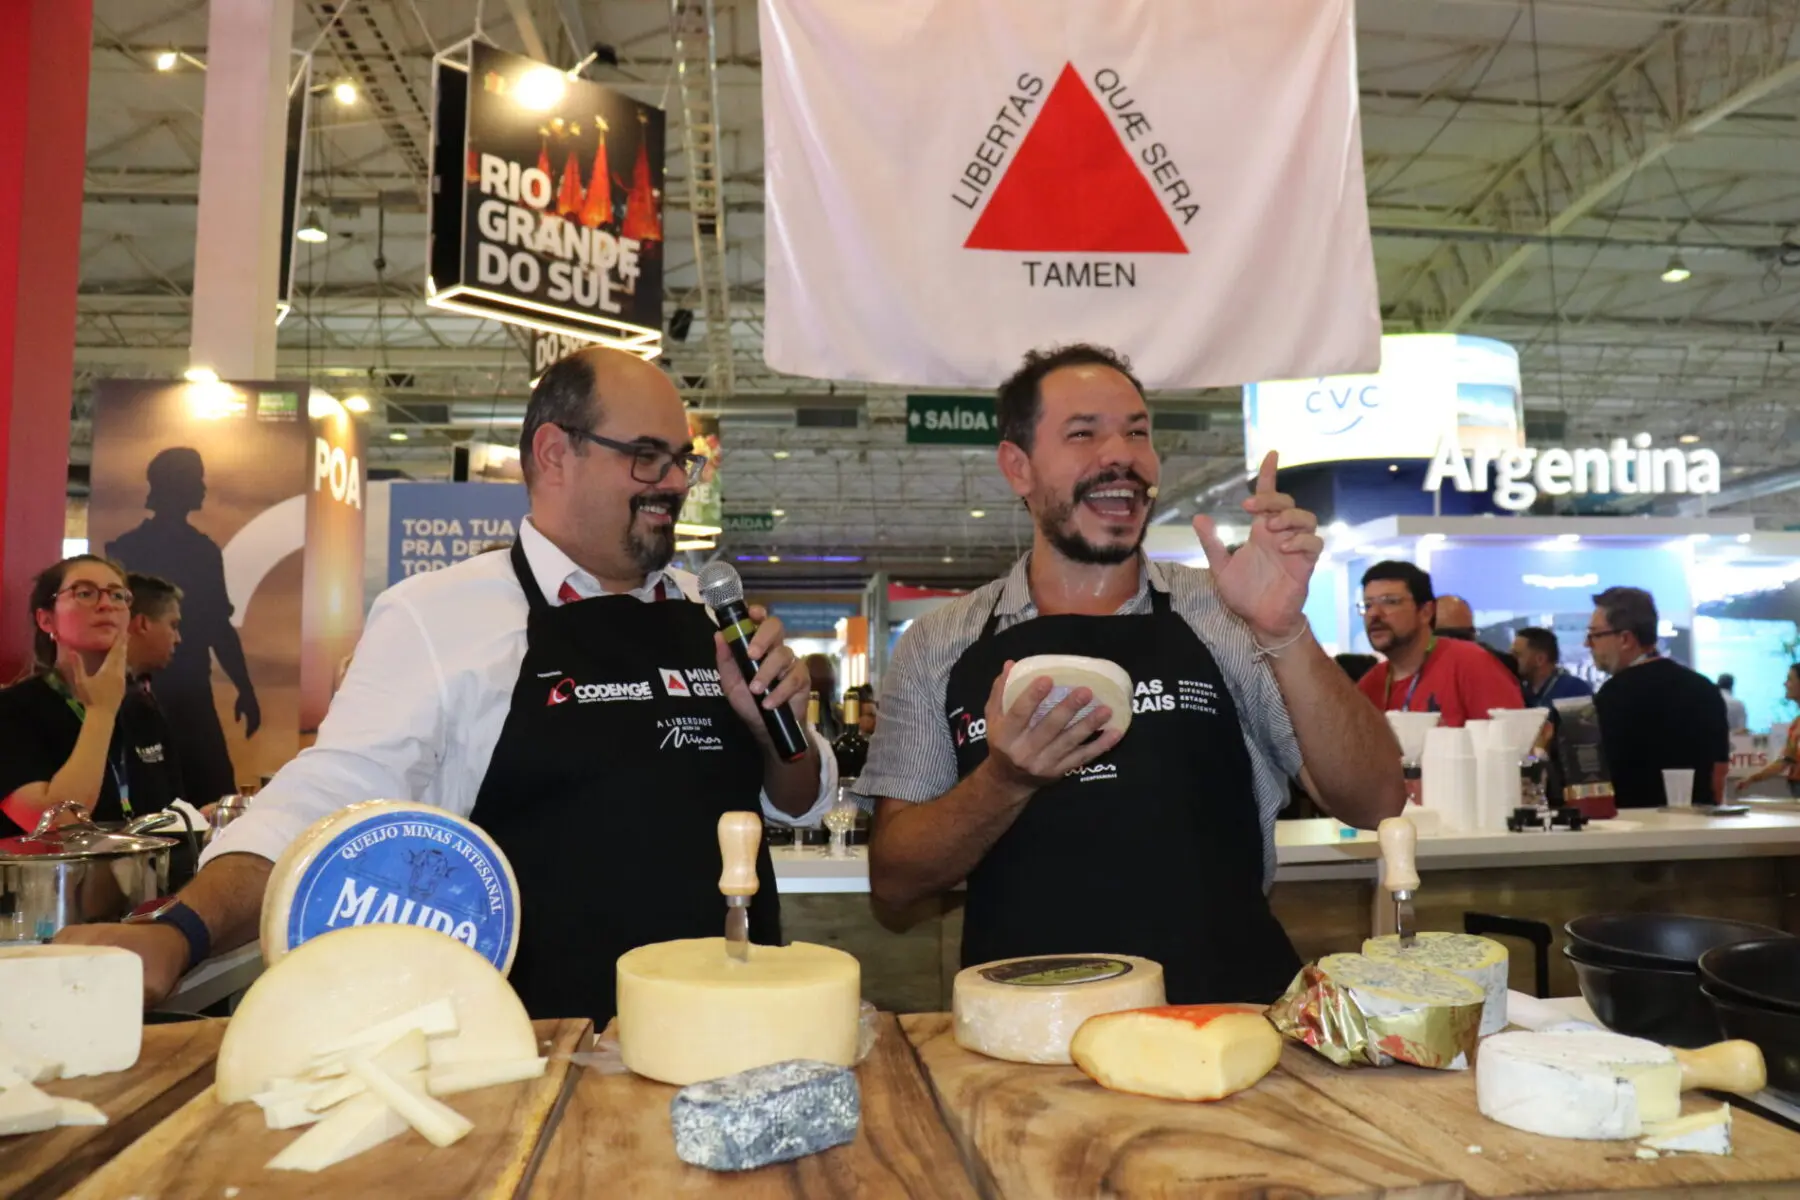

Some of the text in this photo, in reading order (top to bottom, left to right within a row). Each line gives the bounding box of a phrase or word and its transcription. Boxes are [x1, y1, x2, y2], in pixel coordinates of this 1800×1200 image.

[951, 71, 1044, 210] LIBERTAS
[480, 152, 552, 210] RIO
[1141, 141, 1201, 226] SERA
[478, 200, 641, 279] GRANDE
[477, 242, 622, 313] DO SUL
[1022, 260, 1136, 288] TAMEN
[924, 404, 990, 430] SAÍDA
[1305, 384, 1379, 413] CVC
[314, 436, 361, 510] POA
[1422, 431, 1721, 510] Argentina
[401, 539, 446, 556] PRA
[402, 519, 516, 536] TODA TUA
[401, 559, 460, 577] TOD
[1179, 695, 1208, 704] ESTADO
[656, 717, 713, 729] A LIBERDADE
[341, 824, 504, 916] QUEIJO MINAS ARTESANAL
